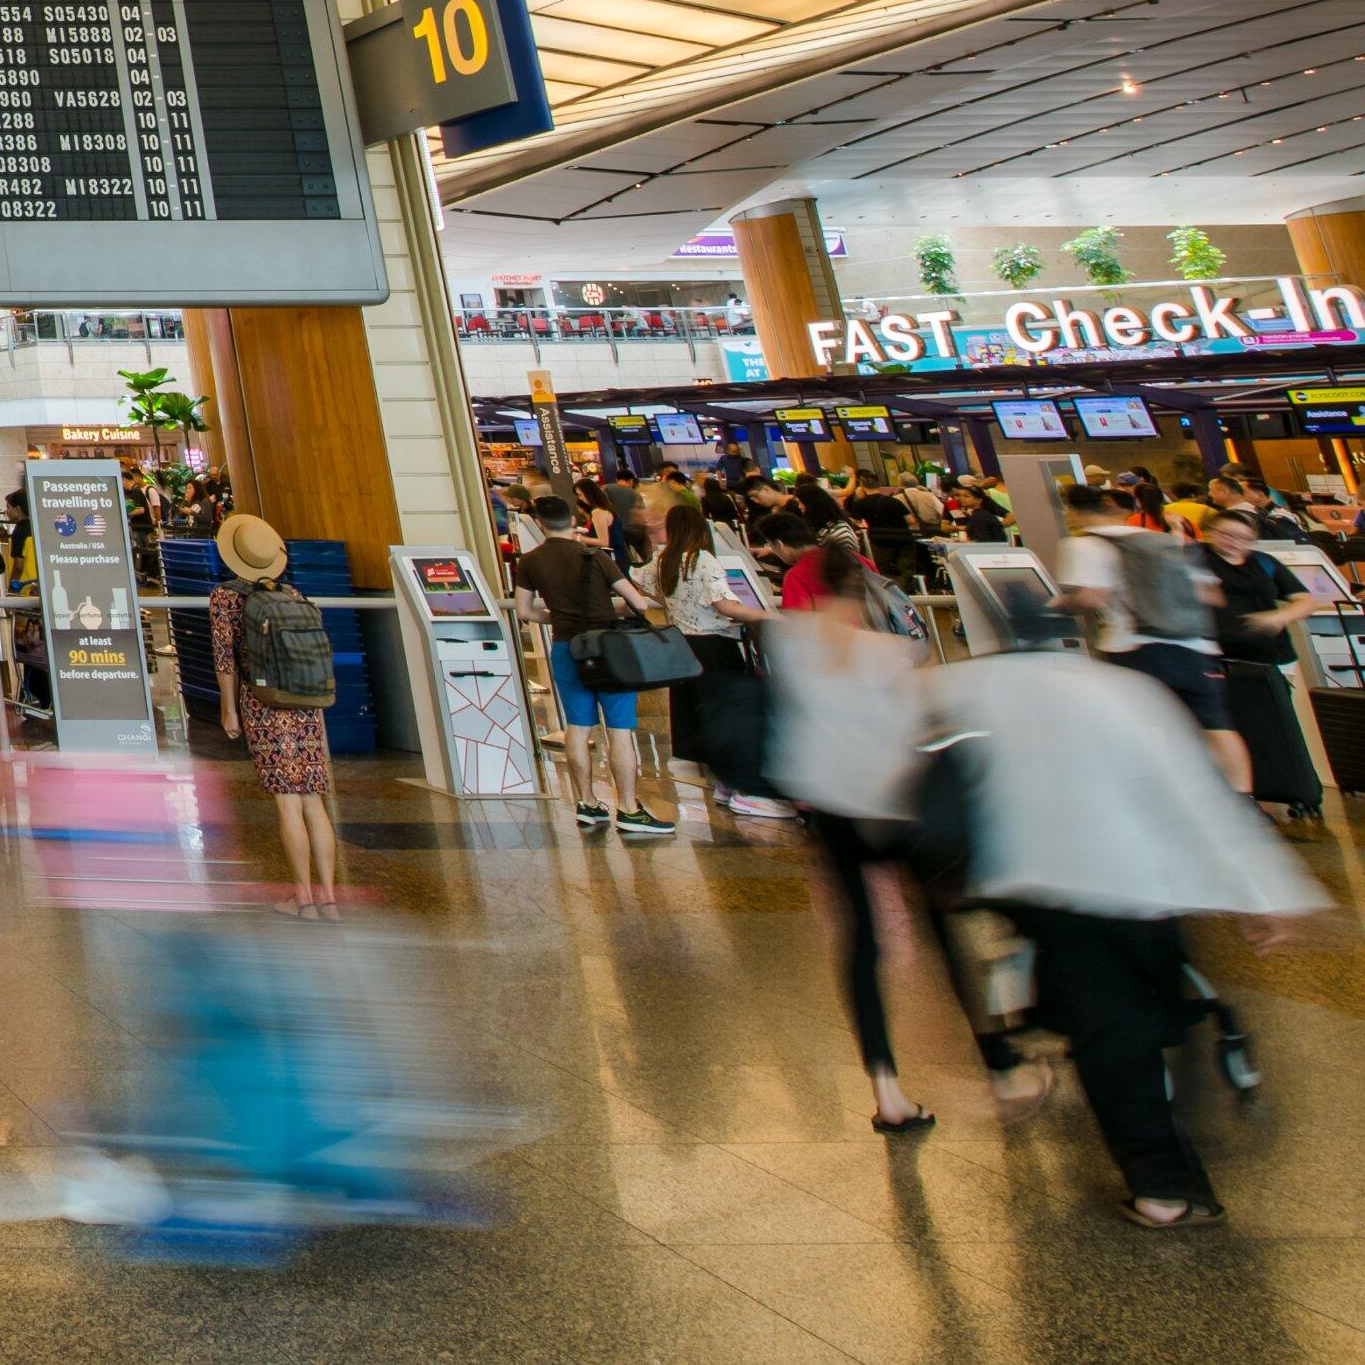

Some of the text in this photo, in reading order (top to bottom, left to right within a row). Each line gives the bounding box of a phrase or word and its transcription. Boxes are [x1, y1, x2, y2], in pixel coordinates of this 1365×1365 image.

[807, 277, 1365, 366] FAST Check-In
[746, 369, 760, 377] AT
[63, 429, 140, 442] Bakery Cuisine
[539, 407, 561, 474] Assistance
[43, 481, 108, 494] Passengers
[42, 496, 112, 510] travelling to
[50, 555, 119, 565] Please purchase
[79, 636, 112, 645] at least
[69, 650, 126, 664] 90 mins
[60, 670, 139, 681] before departure.
